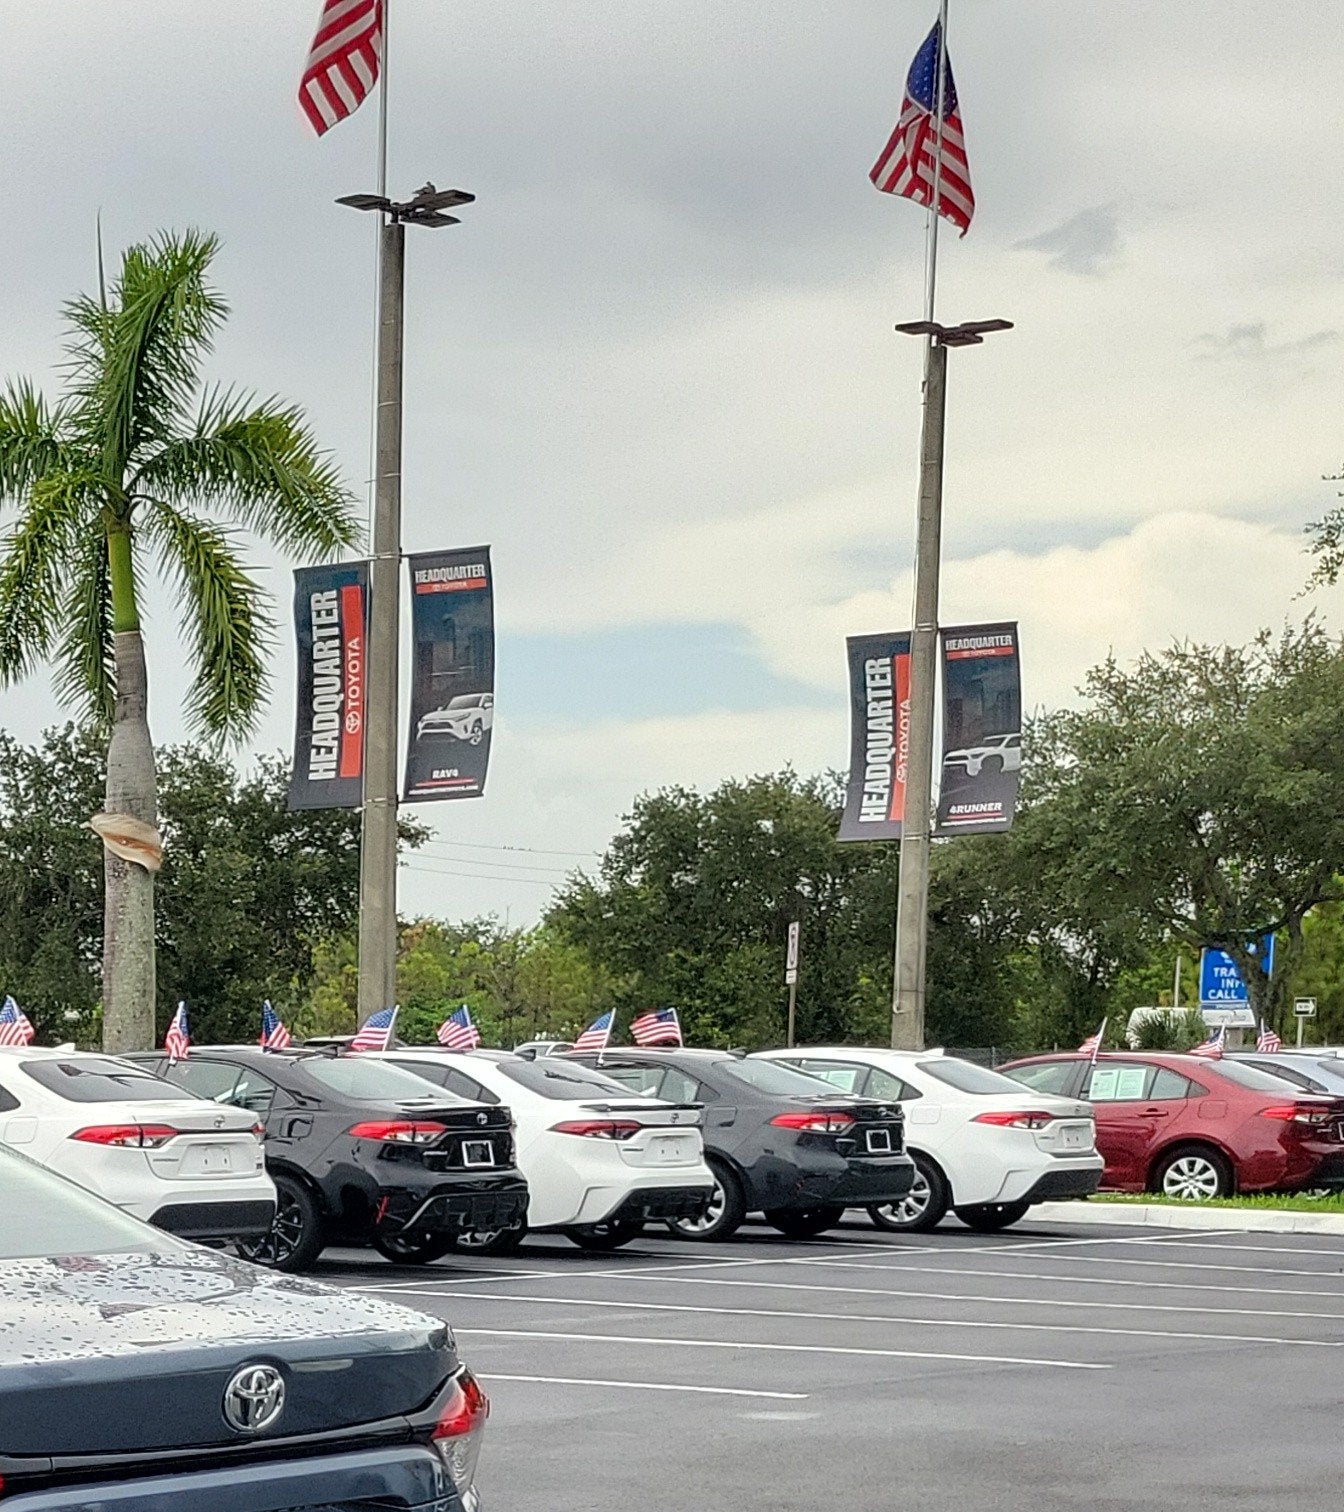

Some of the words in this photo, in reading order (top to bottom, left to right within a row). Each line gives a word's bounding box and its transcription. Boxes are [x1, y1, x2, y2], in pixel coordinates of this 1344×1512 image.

[415, 564, 486, 584] HEADQUARTER
[945, 635, 1012, 651] HEADQUARTER
[347, 637, 361, 710] TOYOTA
[308, 588, 344, 781] HEADQUARTER
[858, 656, 896, 822] HEADQUARTER
[949, 802, 1003, 814] 4RUNNER
[1208, 989, 1238, 1000] CALL
